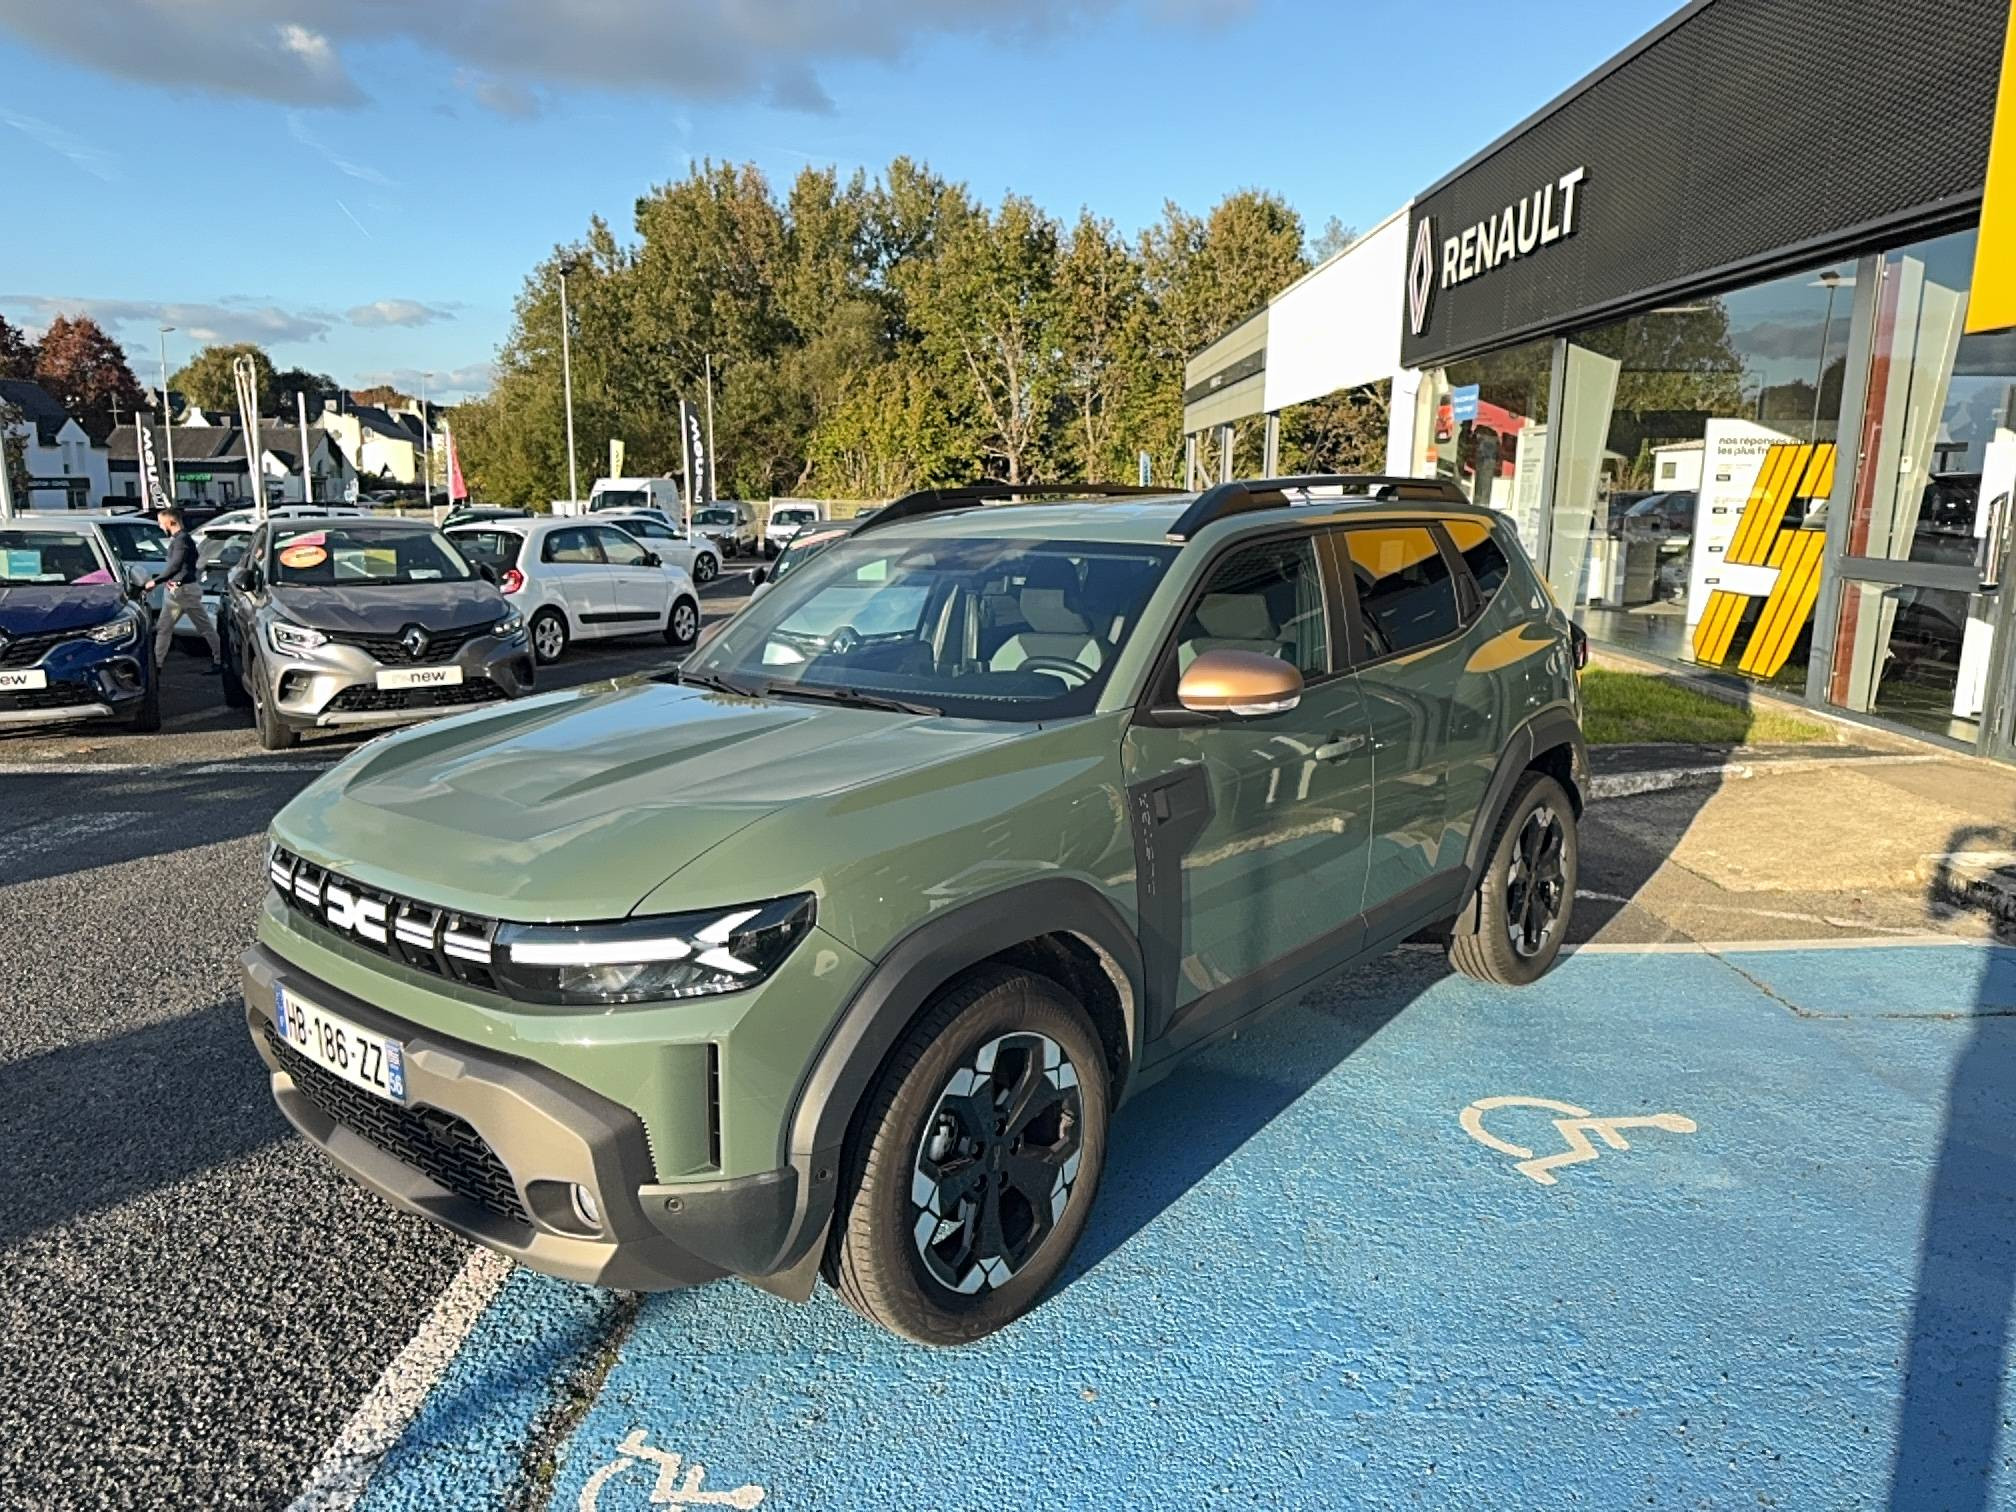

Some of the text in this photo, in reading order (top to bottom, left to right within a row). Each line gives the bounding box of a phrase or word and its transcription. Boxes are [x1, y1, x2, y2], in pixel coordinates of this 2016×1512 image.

[1441, 166, 1584, 289] RENAULT
[1717, 446, 1732, 455] les
[1733, 446, 1756, 456] plus
[1718, 437, 1738, 445] nos
[286, 998, 385, 1089] HB-186-ZZ
[389, 1071, 404, 1096] 56
